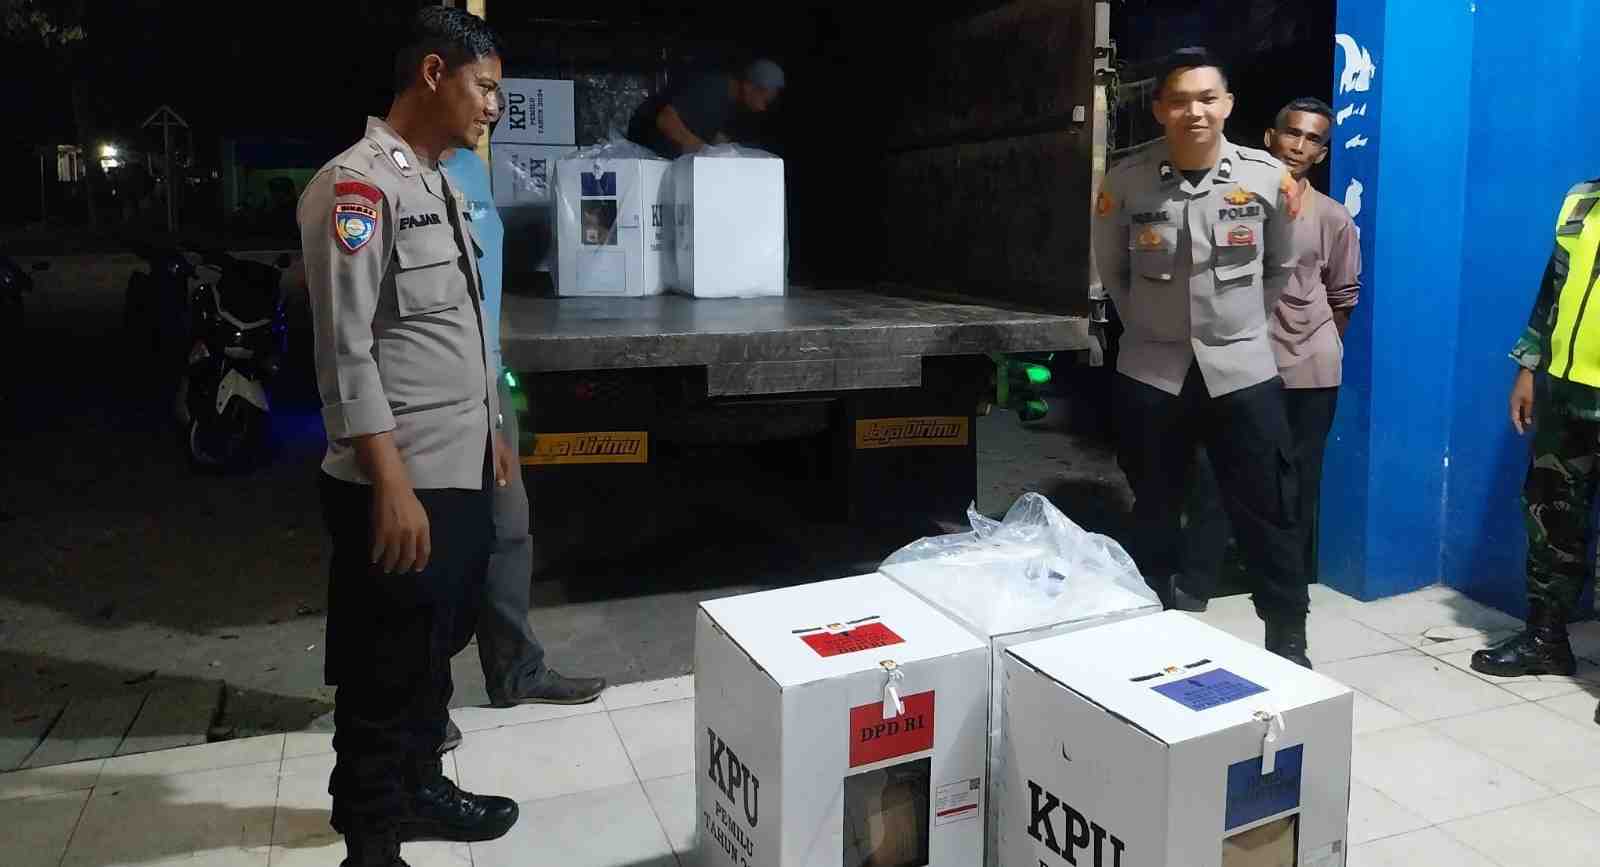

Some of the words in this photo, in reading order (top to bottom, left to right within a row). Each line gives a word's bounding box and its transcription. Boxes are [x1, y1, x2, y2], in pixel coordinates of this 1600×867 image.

[509, 92, 526, 130] KPU
[400, 214, 442, 230] FAJAR
[1218, 206, 1260, 221] POLRI
[572, 433, 641, 456] Dirimu
[903, 418, 961, 439] Dirimu
[858, 720, 900, 743] DPD
[904, 714, 925, 733] RI
[706, 727, 760, 829] KPU
[703, 810, 738, 865] TAHUN
[714, 799, 754, 858] PEMILU
[1027, 779, 1125, 867] KPU
